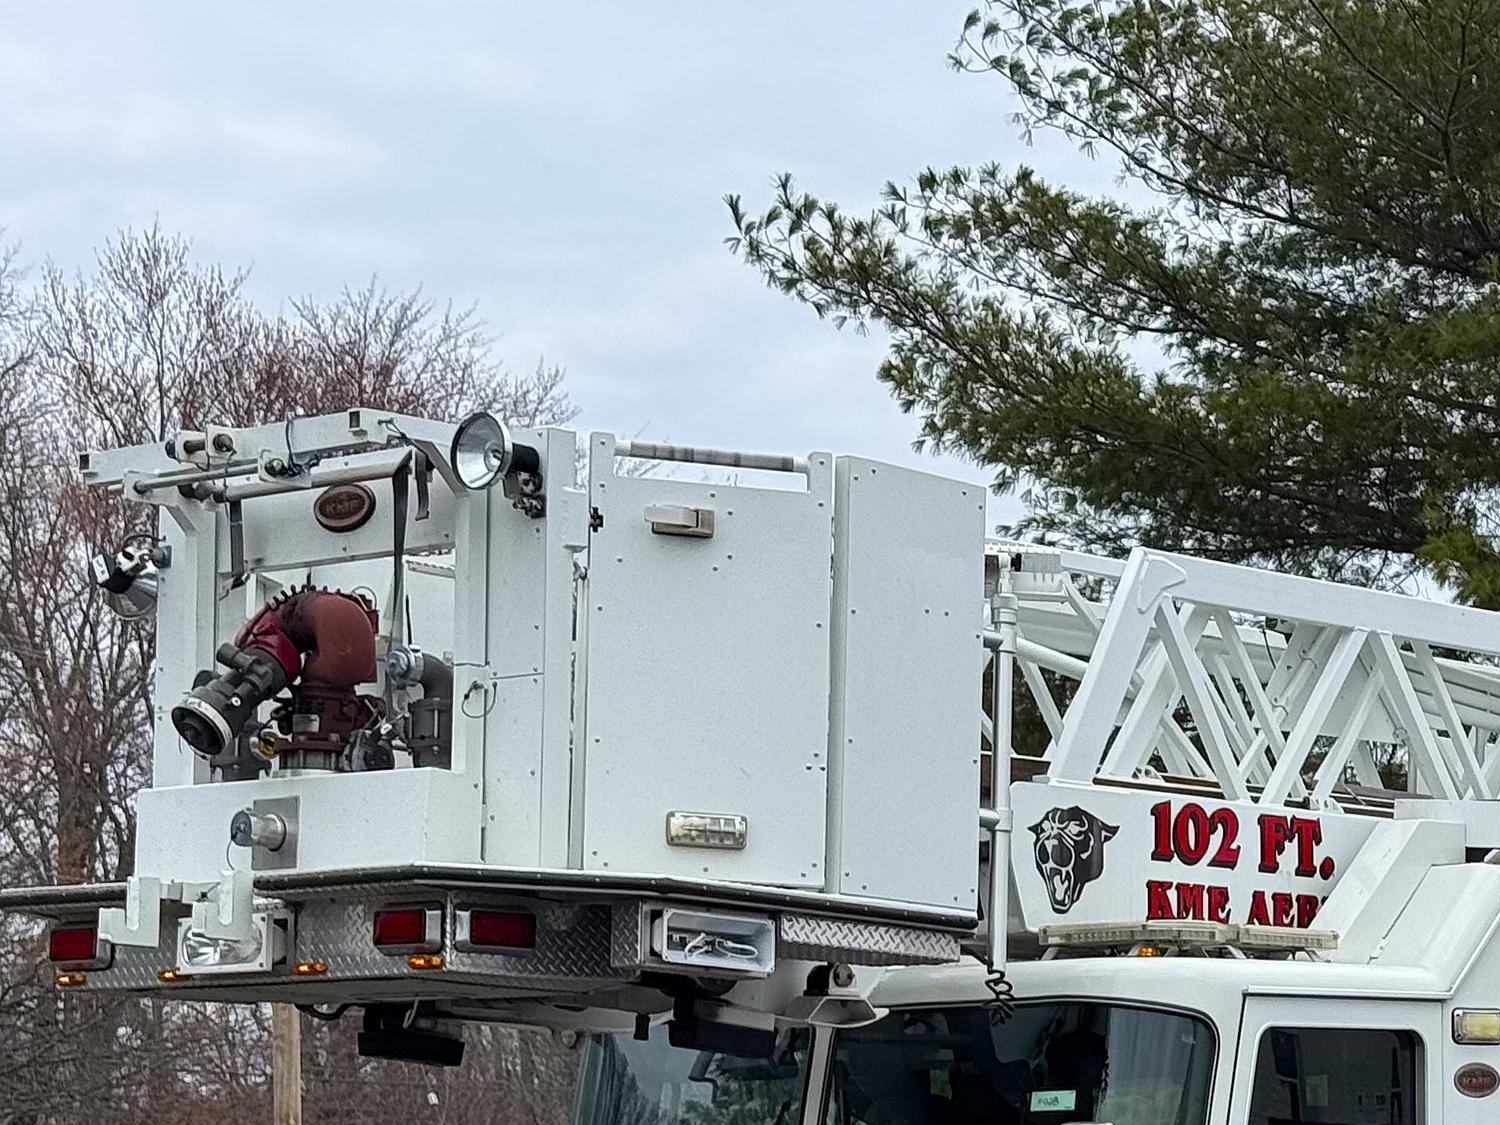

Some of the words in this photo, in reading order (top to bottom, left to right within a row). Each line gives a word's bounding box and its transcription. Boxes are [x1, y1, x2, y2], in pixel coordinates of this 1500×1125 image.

[1150, 800, 1240, 871] 102
[1257, 813, 1335, 881] FT.
[1146, 880, 1231, 924] KME
[1247, 890, 1329, 929] AER
